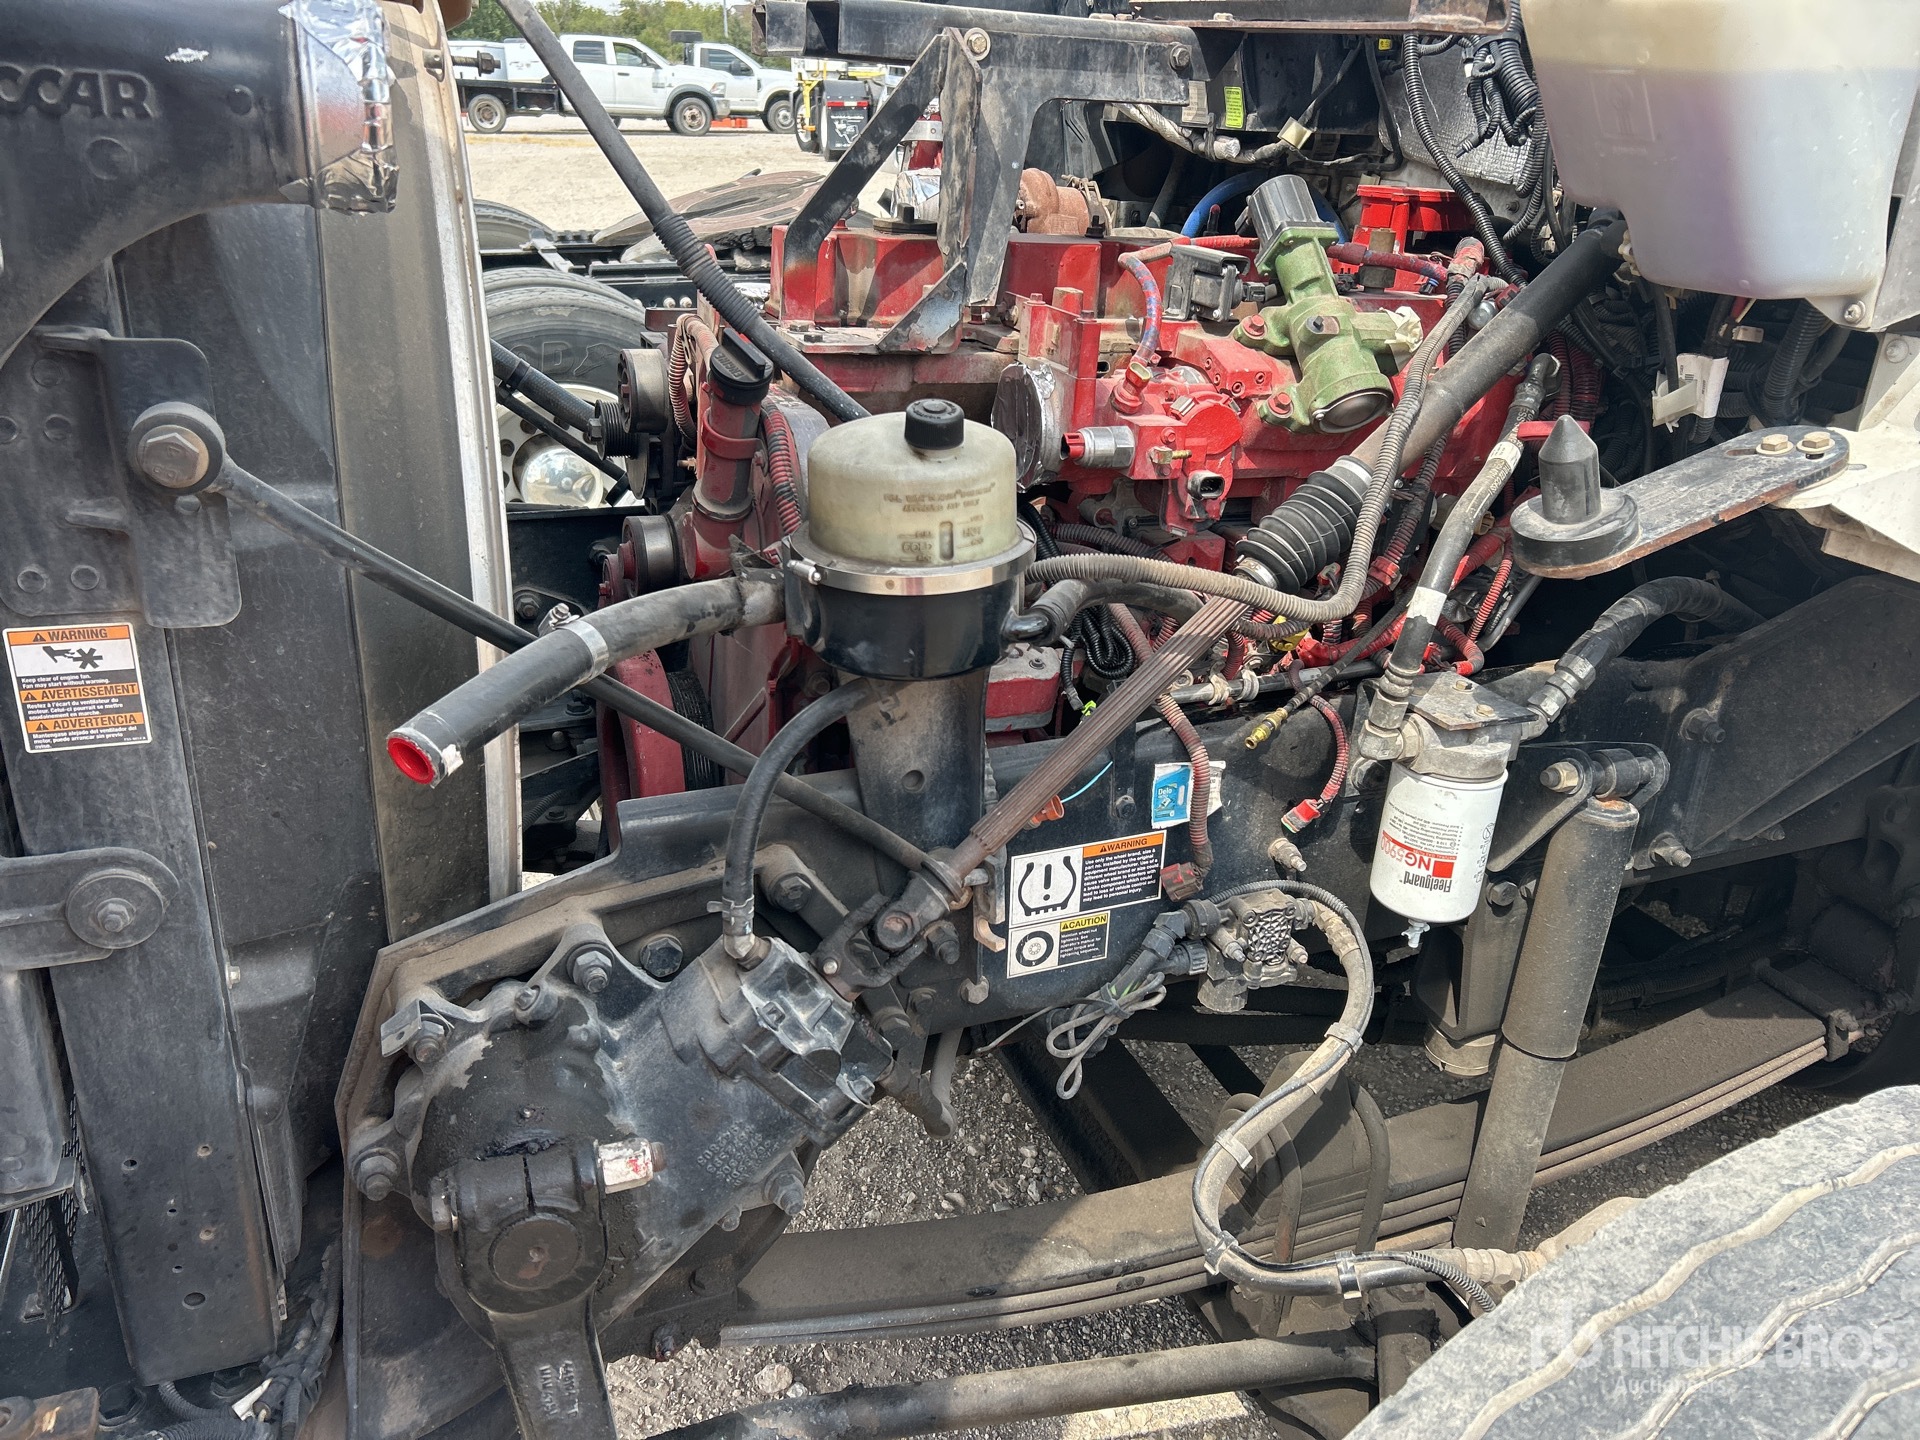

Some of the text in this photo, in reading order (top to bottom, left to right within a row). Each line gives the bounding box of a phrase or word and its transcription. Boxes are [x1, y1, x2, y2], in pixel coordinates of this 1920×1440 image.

[48, 628, 108, 642] WARNING
[35, 682, 47, 690] may
[41, 683, 136, 701] AVERTISSEMENT
[53, 714, 137, 730] ADVERTENCIA
[1158, 787, 1173, 795] Delo
[1107, 838, 1148, 852] WARNING
[1403, 871, 1452, 893] Fleetguard
[1069, 915, 1107, 929] CAUTION
